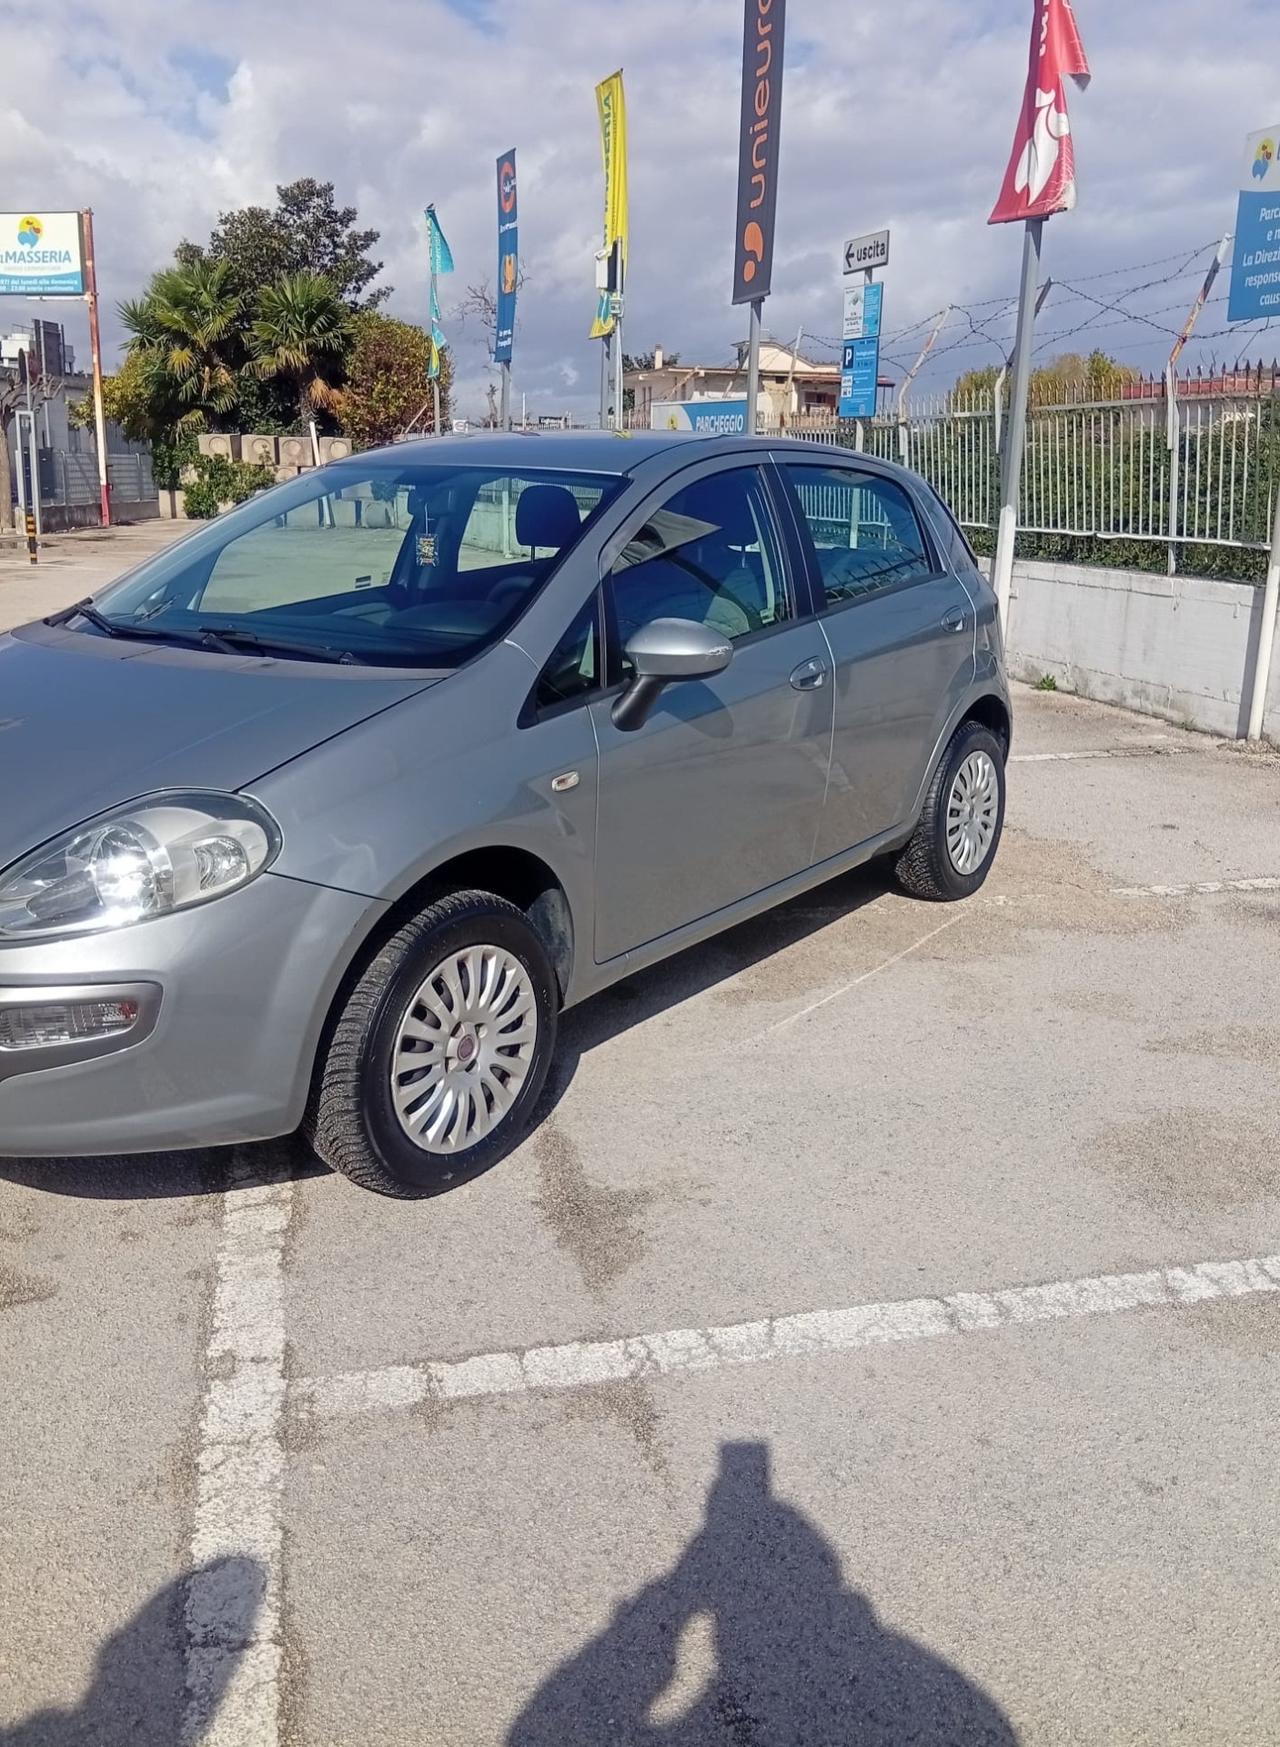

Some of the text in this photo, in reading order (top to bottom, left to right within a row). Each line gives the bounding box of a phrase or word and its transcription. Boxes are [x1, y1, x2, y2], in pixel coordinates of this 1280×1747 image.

[1259, 207, 1280, 222] Parc
[1266, 230, 1273, 241] e
[857, 240, 886, 262] uscita
[1242, 253, 1253, 267] La
[845, 348, 852, 366] P
[695, 414, 744, 432] PARCHEGGIO
